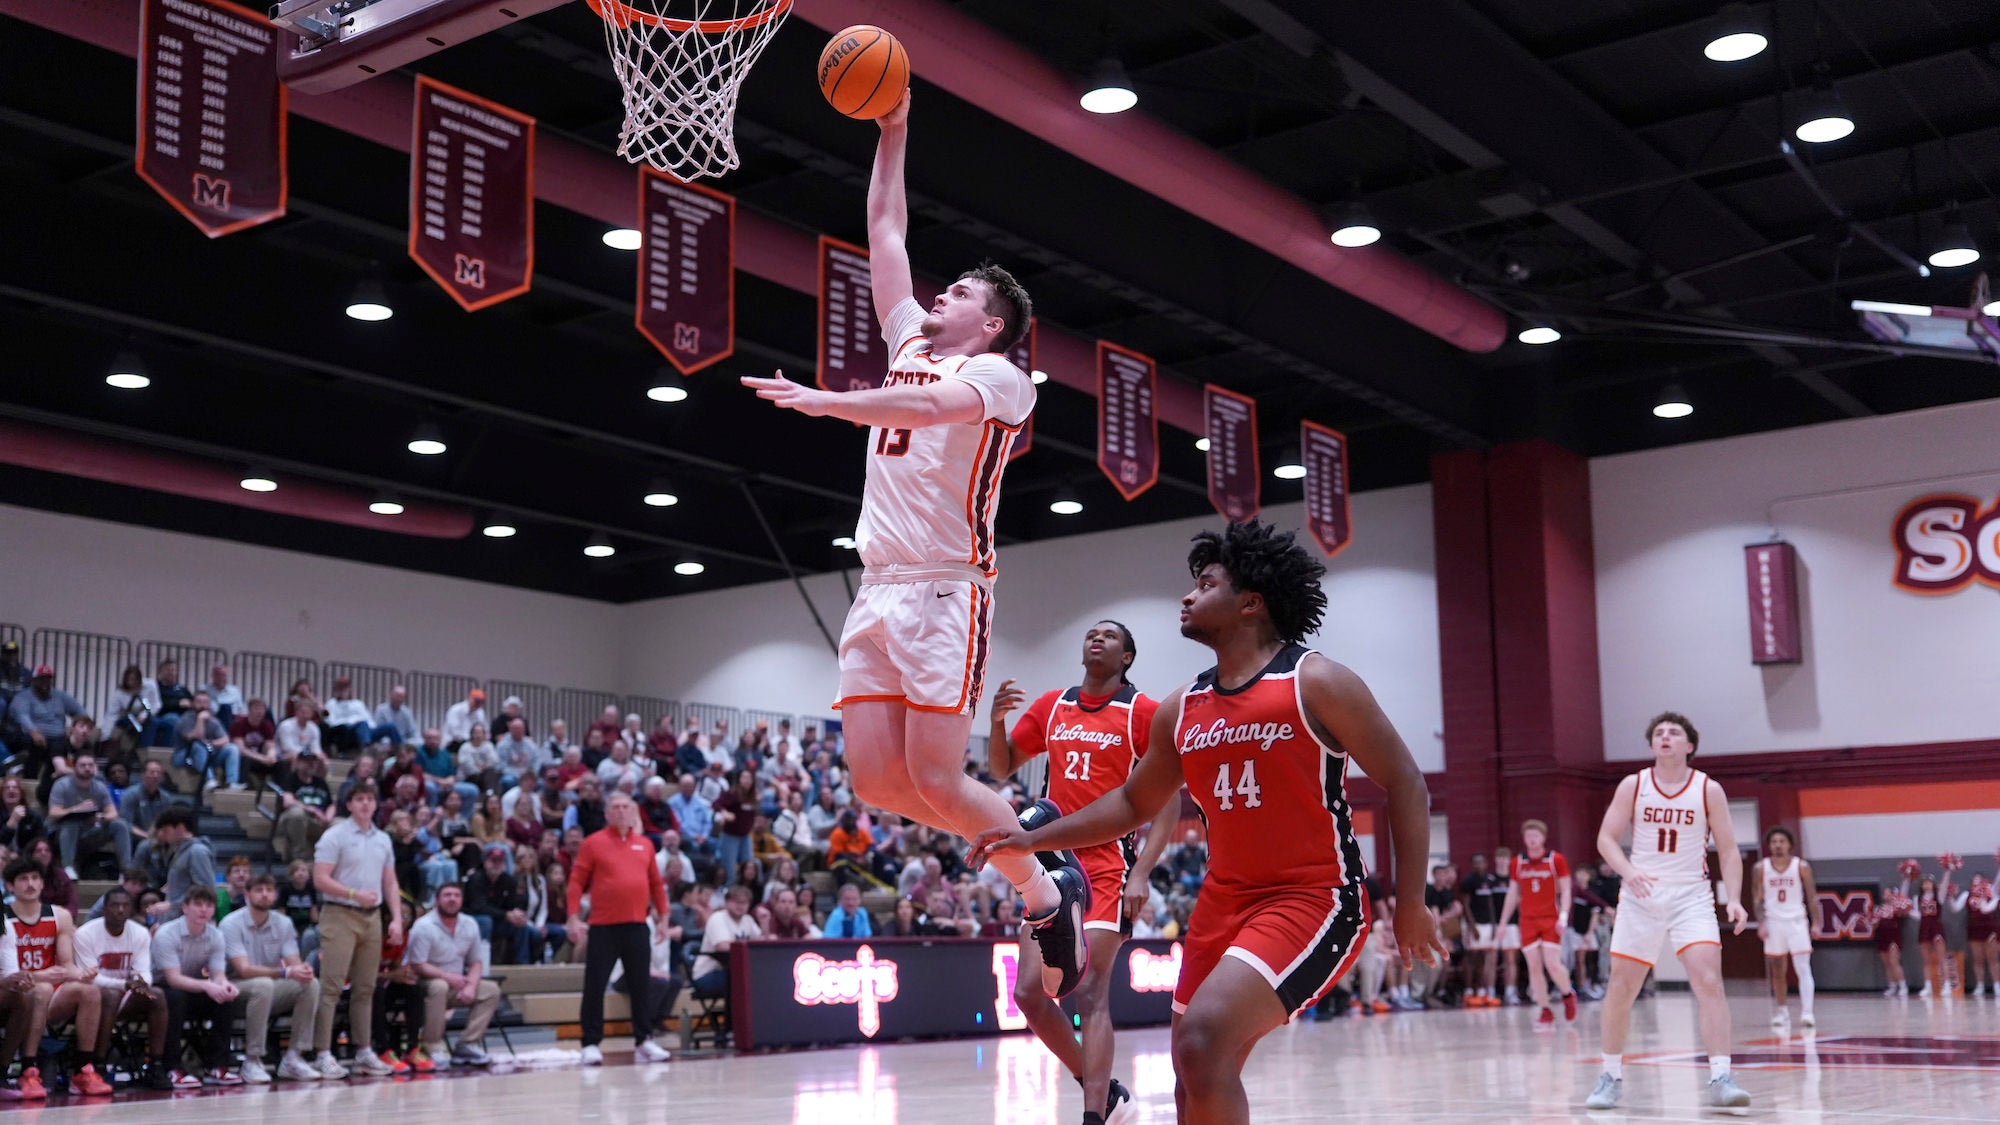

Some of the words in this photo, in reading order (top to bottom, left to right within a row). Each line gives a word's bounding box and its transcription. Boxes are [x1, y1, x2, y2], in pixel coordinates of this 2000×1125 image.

[211, 10, 272, 43] VOLLEYBALL
[820, 37, 861, 87] Wilson
[193, 173, 231, 212] M
[455, 253, 485, 289] M
[674, 322, 699, 354] M
[1050, 723, 1122, 750] LaGrange
[1180, 718, 1294, 755] LaGrange
[1064, 750, 1091, 780] 21
[1213, 759, 1262, 811] 44
[1643, 807, 1695, 825] SCOTS
[1657, 828, 1677, 853] 11
[1778, 889, 1786, 902] 0
[1815, 889, 1873, 939] M
[22, 950, 44, 969] 35
[793, 944, 898, 1038] Scots
